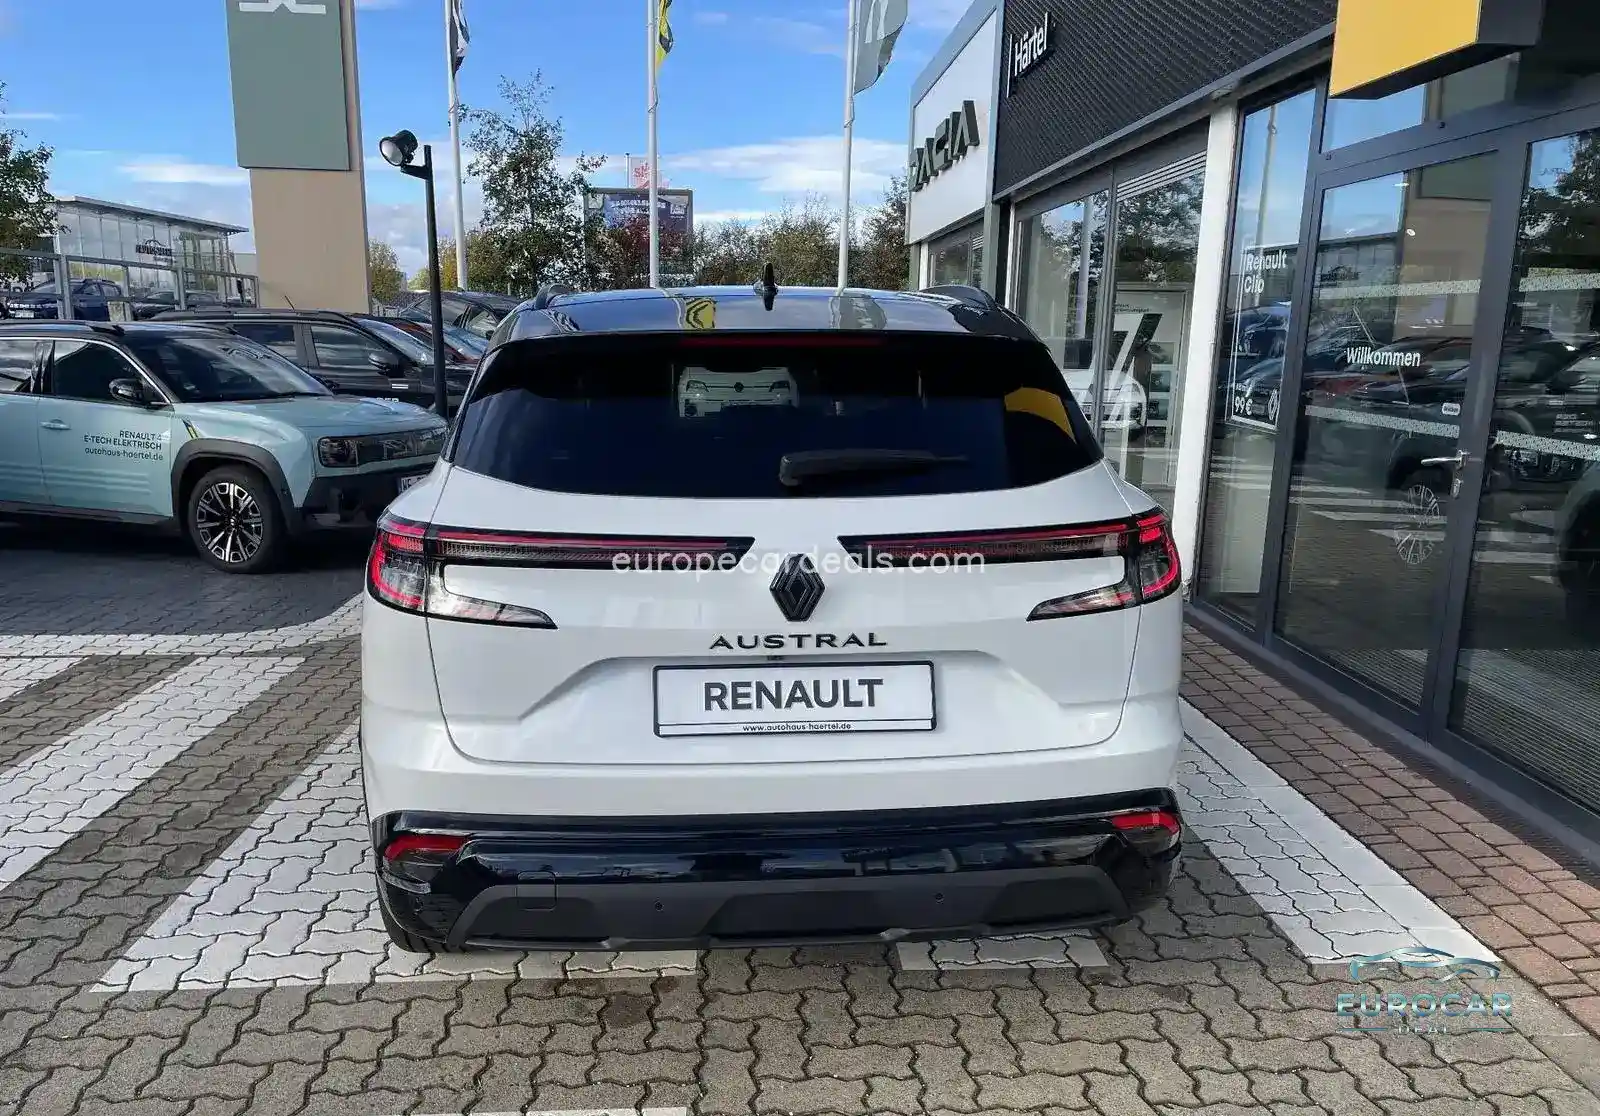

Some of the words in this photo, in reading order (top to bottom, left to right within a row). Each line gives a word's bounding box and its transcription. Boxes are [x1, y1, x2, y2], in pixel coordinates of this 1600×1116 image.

[1014, 12, 1048, 77] Härtel
[1246, 248, 1287, 271] Renault
[1244, 274, 1265, 293] Clio
[1345, 346, 1421, 367] Willkommen
[83, 434, 111, 445] E-TECH
[113, 438, 162, 451] ELEKTRISCH
[119, 430, 156, 441] RENAULT
[84, 447, 164, 461] autohaus-haertel.de
[709, 632, 887, 650] AUSTRAL
[704, 678, 884, 711] RENAULT
[742, 722, 852, 732] www.autohaus-haertel.de
